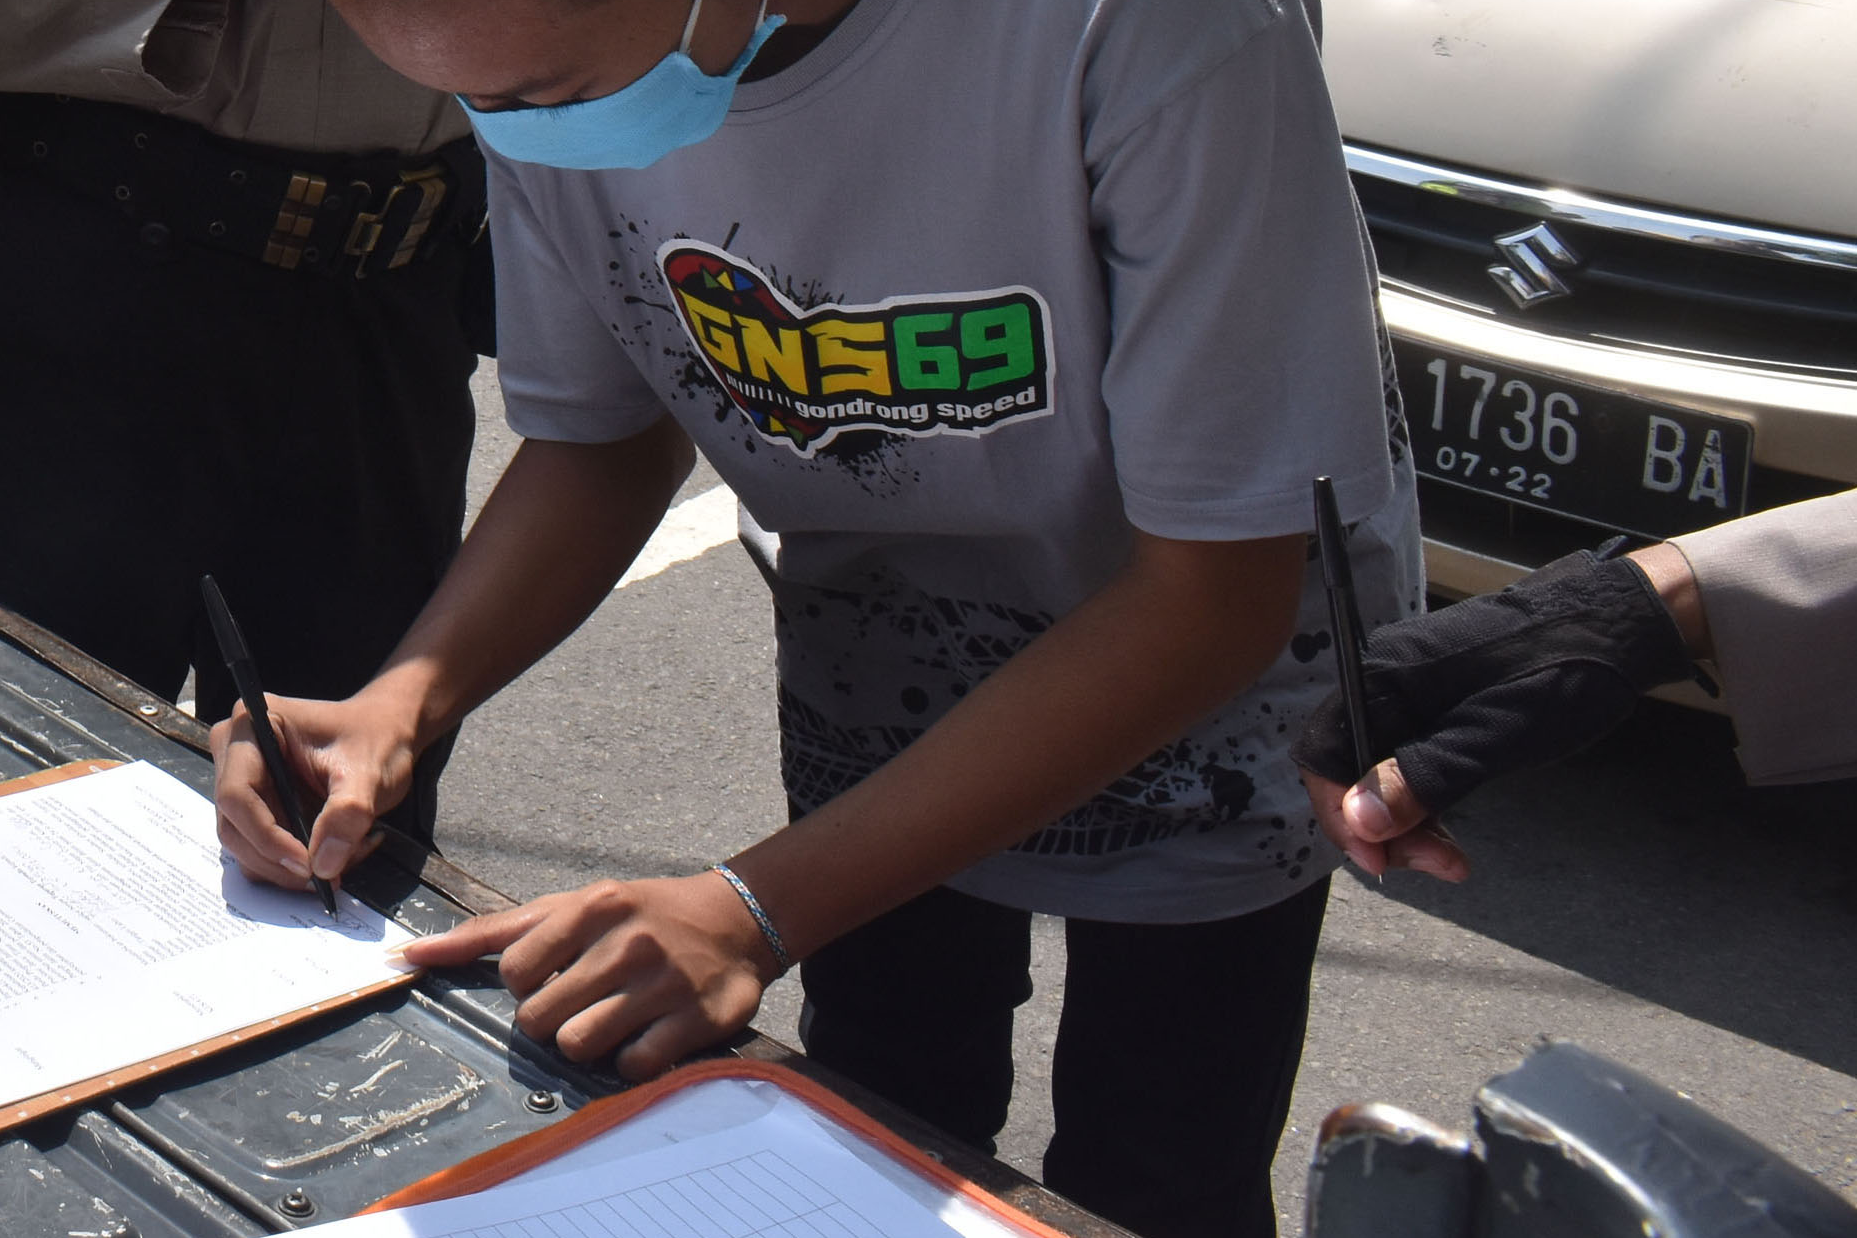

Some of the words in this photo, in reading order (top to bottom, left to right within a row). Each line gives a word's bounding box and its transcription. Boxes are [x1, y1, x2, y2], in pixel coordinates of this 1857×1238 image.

[795, 397, 929, 423] gondrong
[936, 386, 1036, 421] speed
[1426, 358, 1580, 464] 1736
[1644, 414, 1727, 509] BA
